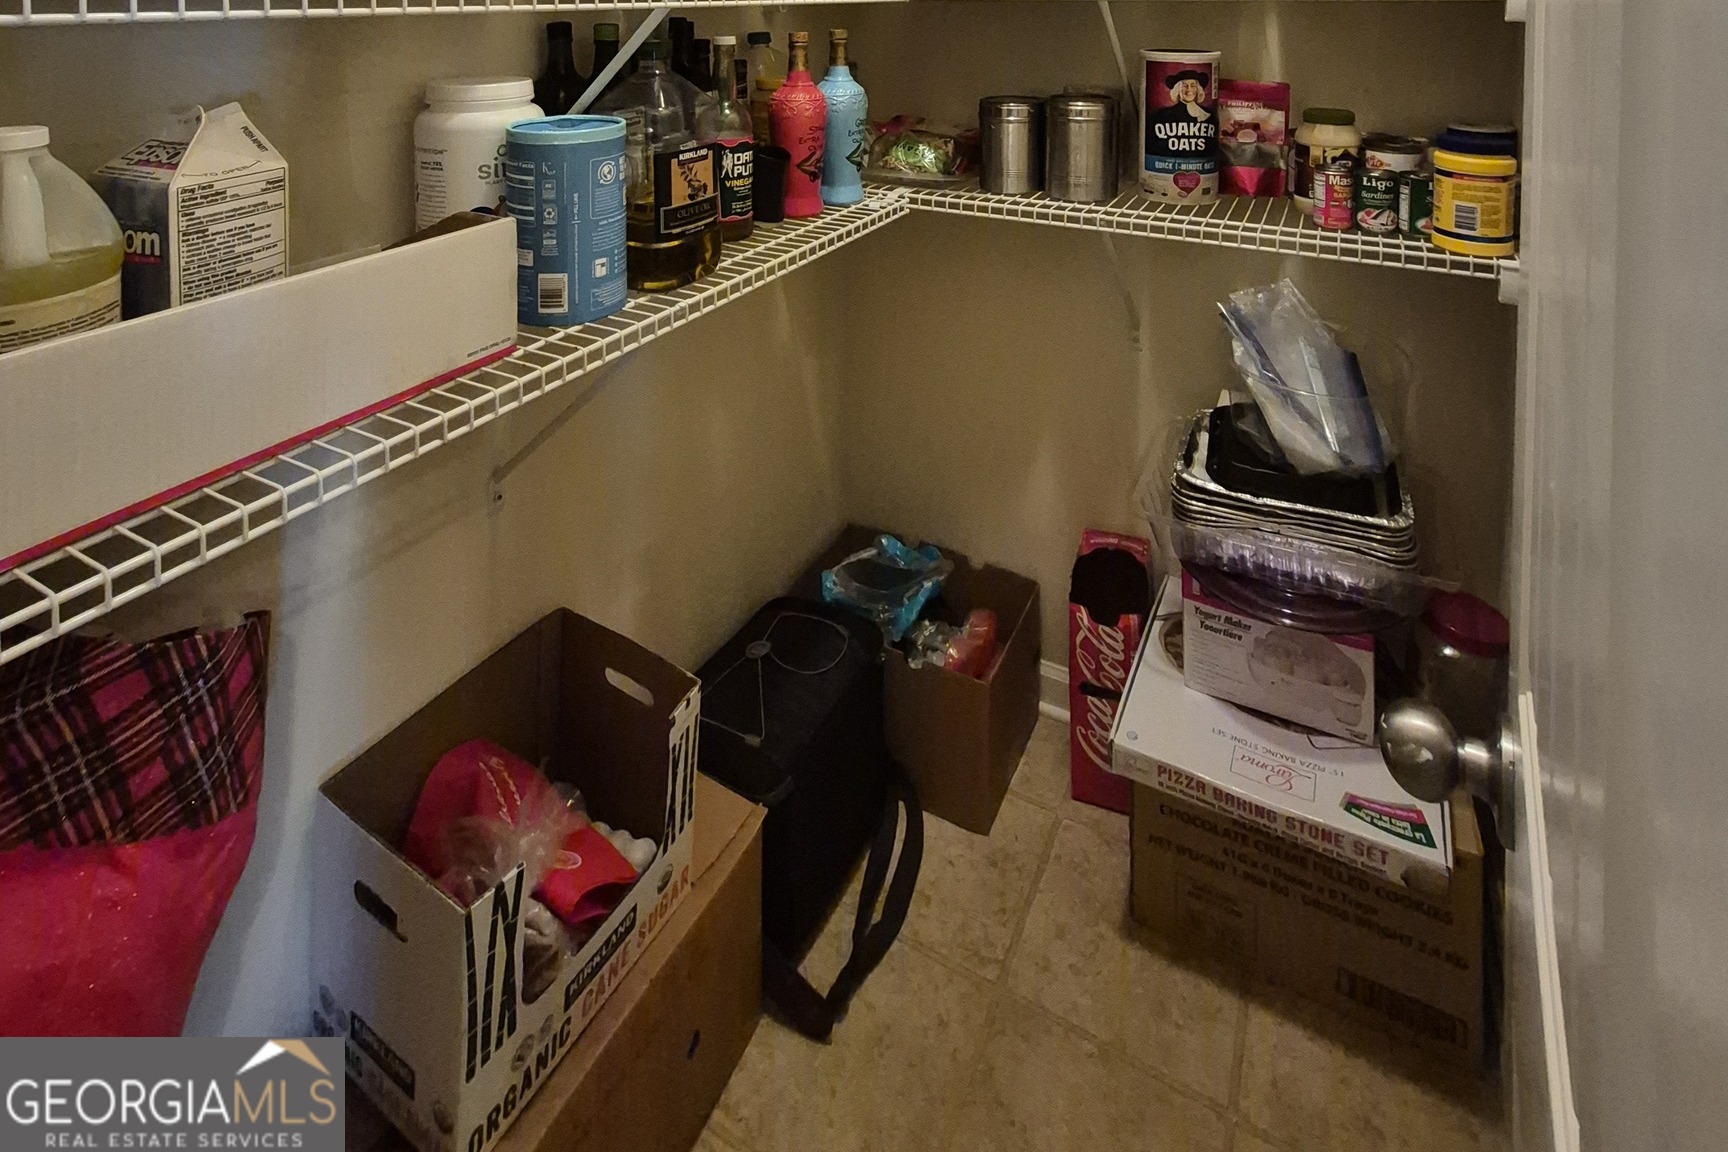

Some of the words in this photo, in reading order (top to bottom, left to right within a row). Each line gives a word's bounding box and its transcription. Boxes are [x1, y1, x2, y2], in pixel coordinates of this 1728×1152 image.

[1154, 122, 1216, 139] QUAKER
[1168, 138, 1206, 151] OATS
[679, 148, 708, 161] KIRKLAND
[734, 150, 753, 164] DAT
[734, 165, 753, 177] PUT
[725, 176, 753, 187] VINEGA
[1329, 175, 1352, 186] Mas
[1363, 177, 1394, 191] Ligo
[1361, 190, 1394, 200] Sardines
[1076, 606, 1125, 771] CocaCola
[1261, 747, 1296, 765] BAKING
[1299, 760, 1326, 773] PIZZA
[1156, 764, 1207, 796] PIZZA
[1212, 786, 1278, 824] BAKING
[1285, 814, 1345, 847] STONE
[1352, 838, 1390, 867] SET
[637, 864, 690, 948] SUGAR
[569, 911, 636, 996] KIRKLAND
[582, 940, 631, 1019] CANE
[468, 1016, 572, 1152] ORGANIC
